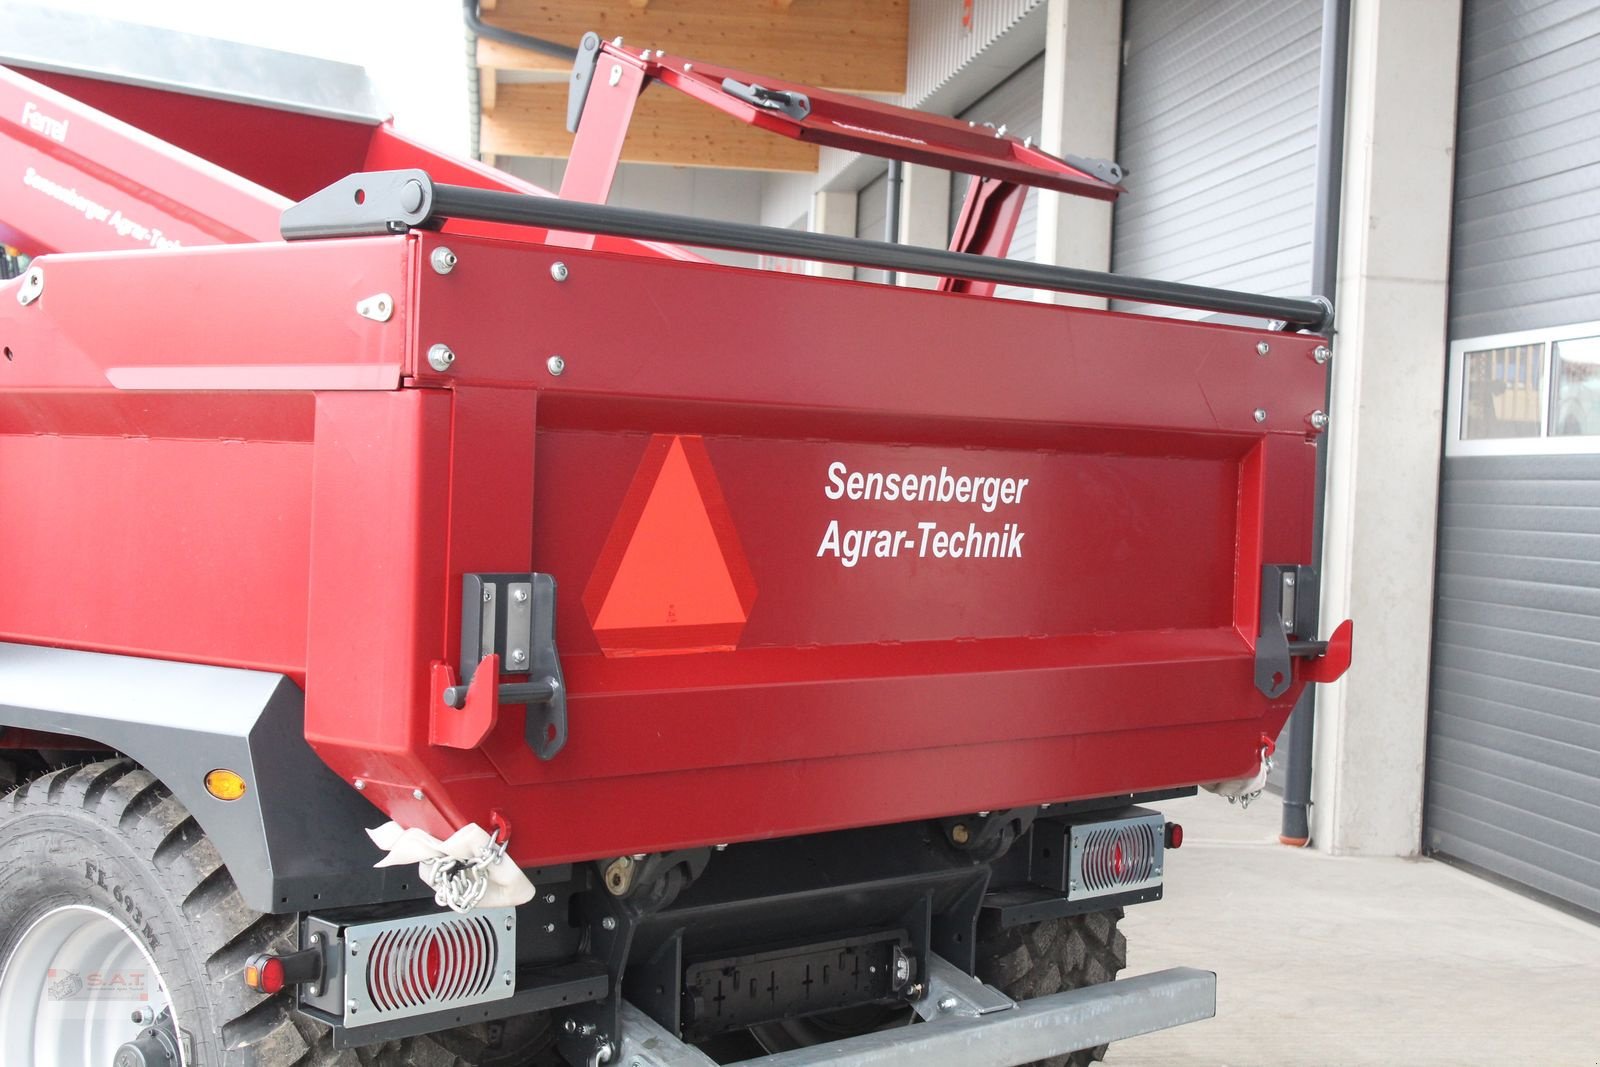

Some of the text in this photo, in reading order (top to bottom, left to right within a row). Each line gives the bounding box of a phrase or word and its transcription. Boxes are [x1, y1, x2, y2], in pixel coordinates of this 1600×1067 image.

[824, 461, 1029, 513] Sensenberger
[816, 520, 1025, 567] Agrar-Technik
[113, 885, 142, 925] 693
